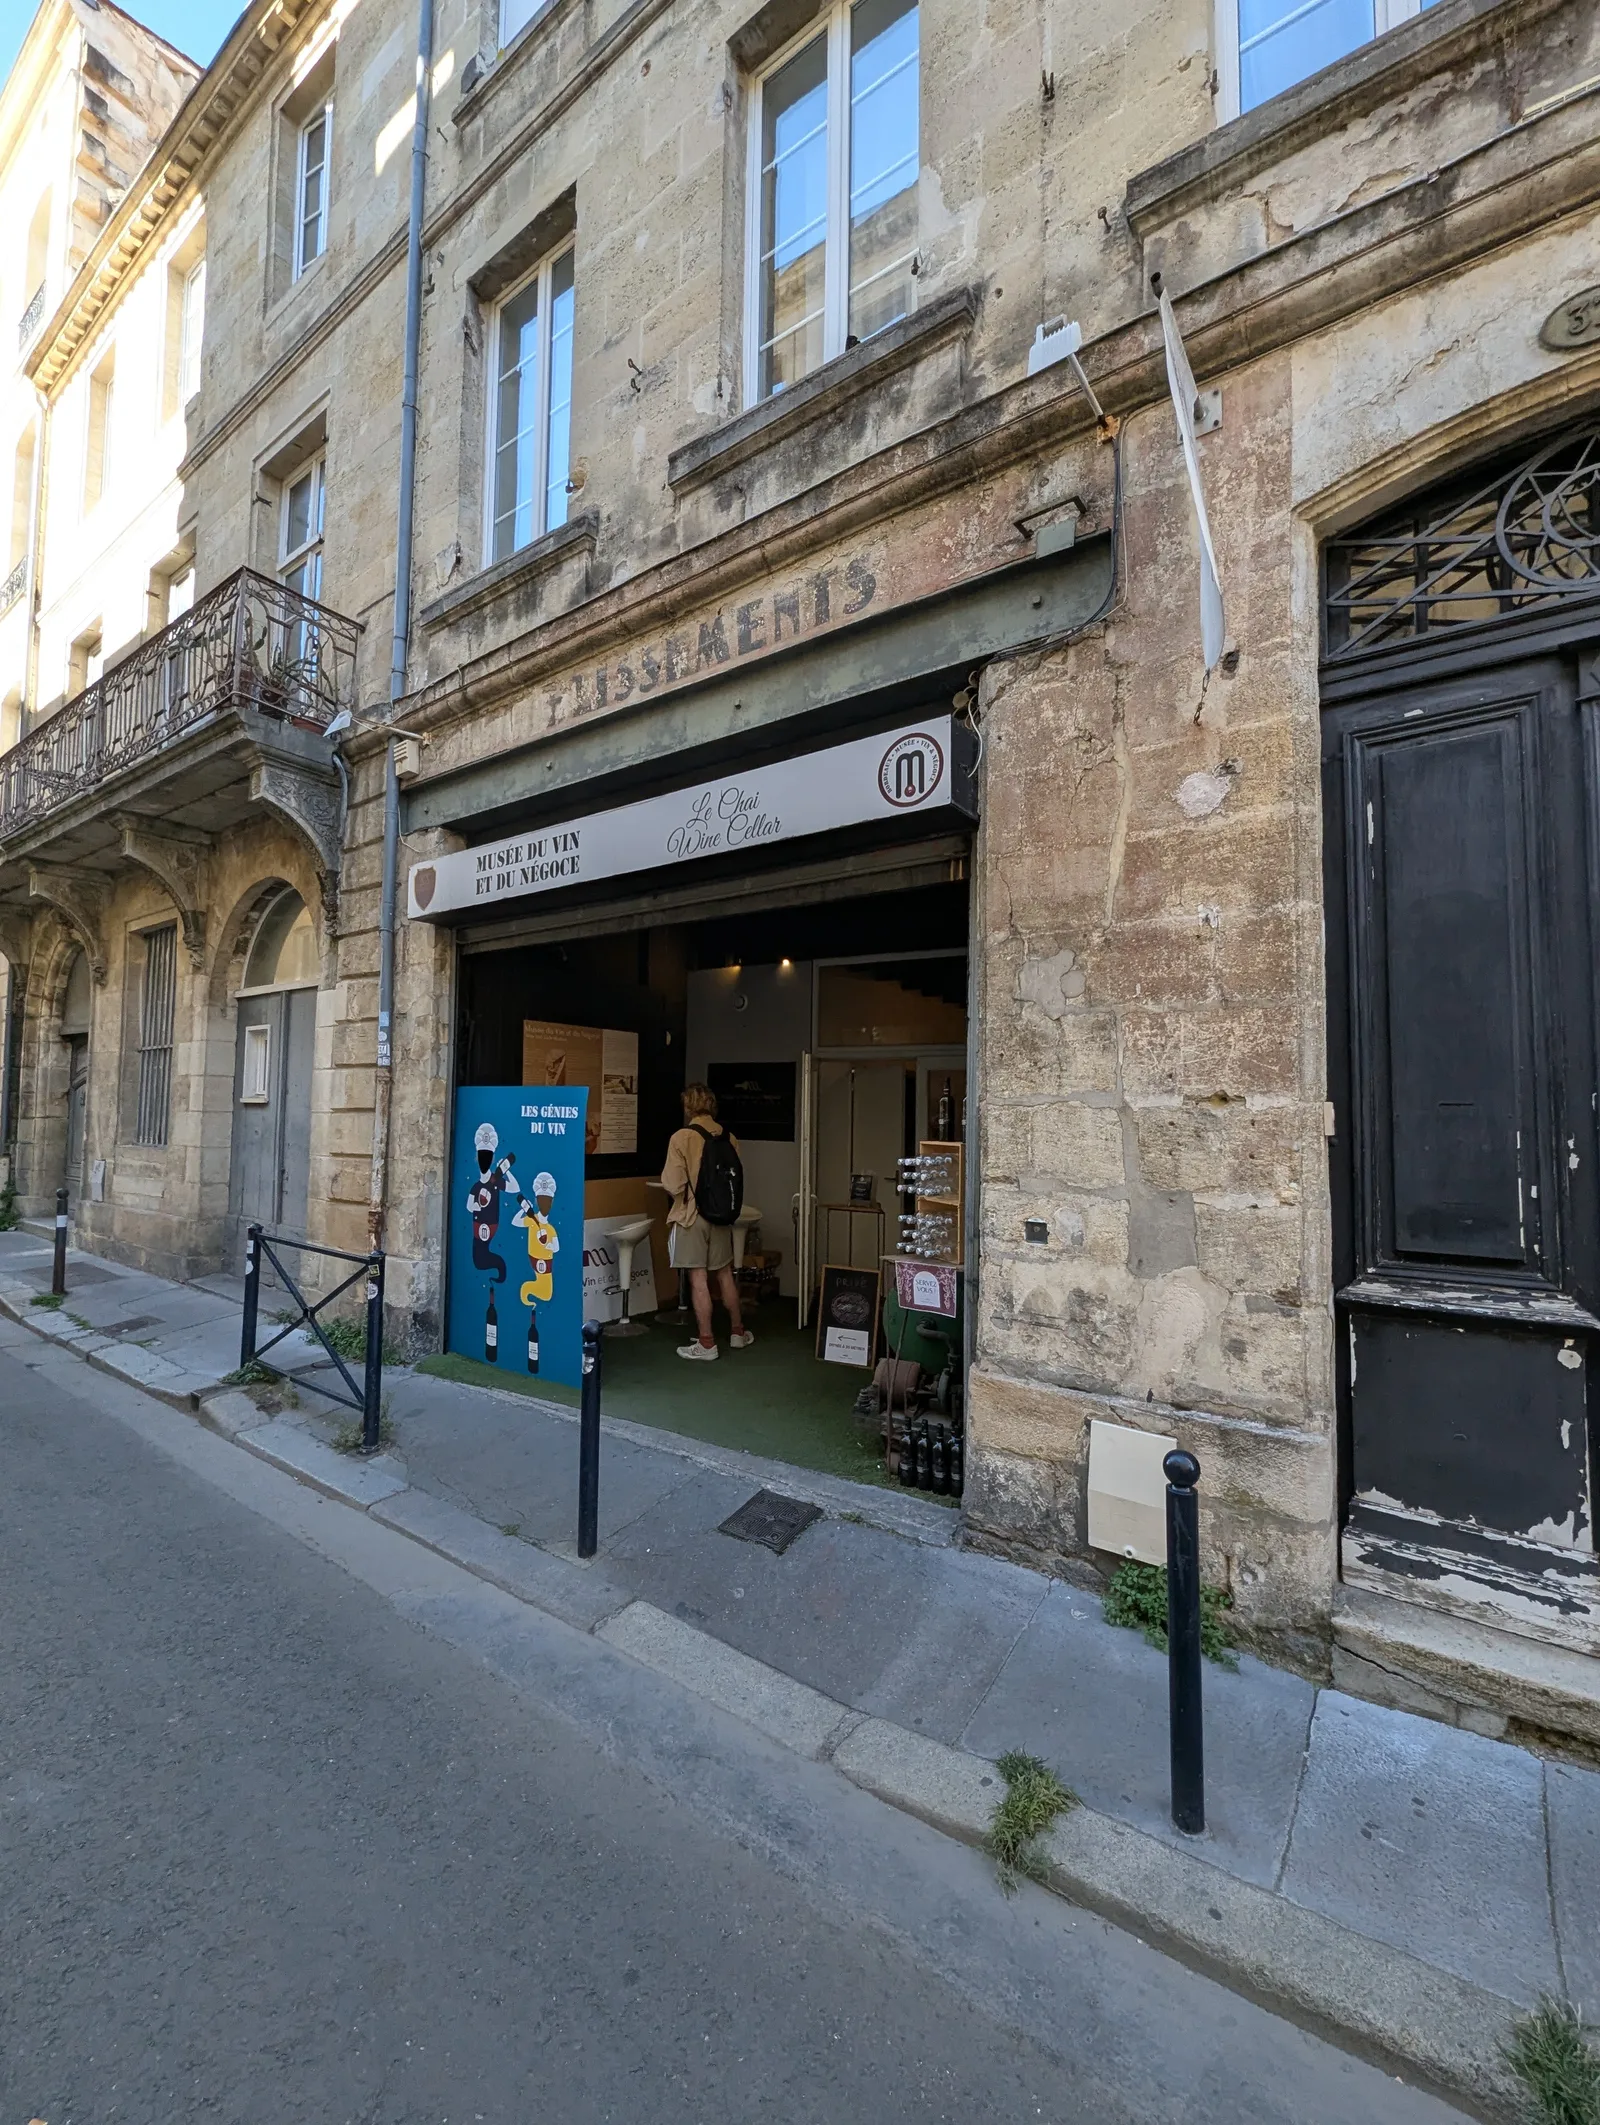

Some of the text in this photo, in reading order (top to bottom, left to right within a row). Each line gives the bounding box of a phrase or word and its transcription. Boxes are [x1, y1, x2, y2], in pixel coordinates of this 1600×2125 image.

[883, 759, 893, 794] BORDEAUX
[920, 740, 931, 750] VIN
[686, 787, 760, 831] Le Chai
[476, 830, 581, 873] MUSÉE DU VIN
[667, 813, 782, 858] Wine Cellar
[476, 855, 580, 896] ET DU NÉGOCE
[521, 1103, 579, 1119] LES GÉNIES
[530, 1122, 566, 1135] DU VIN
[915, 1279, 937, 1288] SERVEZ
